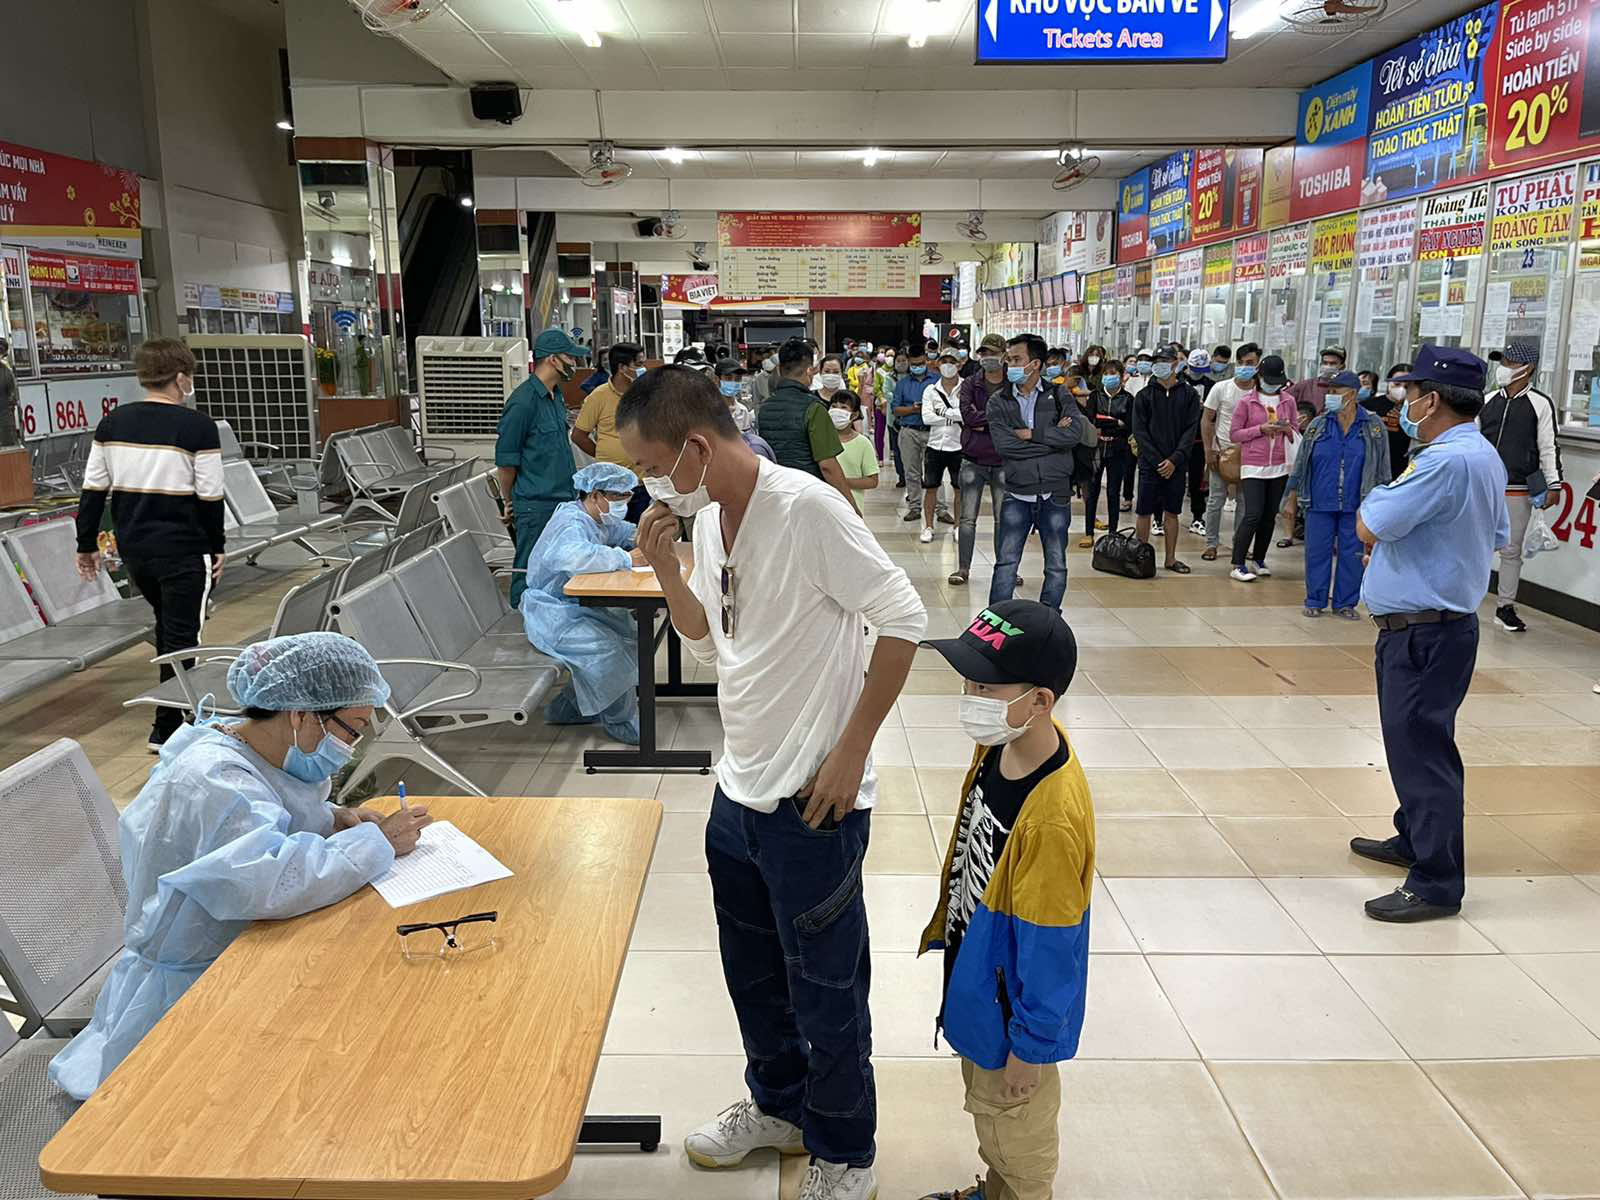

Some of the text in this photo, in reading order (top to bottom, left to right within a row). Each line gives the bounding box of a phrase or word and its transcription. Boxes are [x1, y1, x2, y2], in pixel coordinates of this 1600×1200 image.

[1043, 27, 1163, 48] Tickets Area
[1505, 35, 1532, 61] Side
[1535, 30, 1551, 52] by
[1425, 38, 1461, 77] chia
[1502, 63, 1543, 96] HOÀN
[1375, 102, 1404, 130] HOÀN
[1505, 82, 1569, 151] 20%
[1372, 135, 1399, 159] TRAO
[1299, 166, 1351, 199] TOSHIBA
[1496, 196, 1573, 216] KON TUM
[1420, 246, 1480, 260] KON TUM
[1522, 248, 1535, 268] 23
[56, 400, 88, 430] 86A
[1551, 482, 1597, 549] 24
